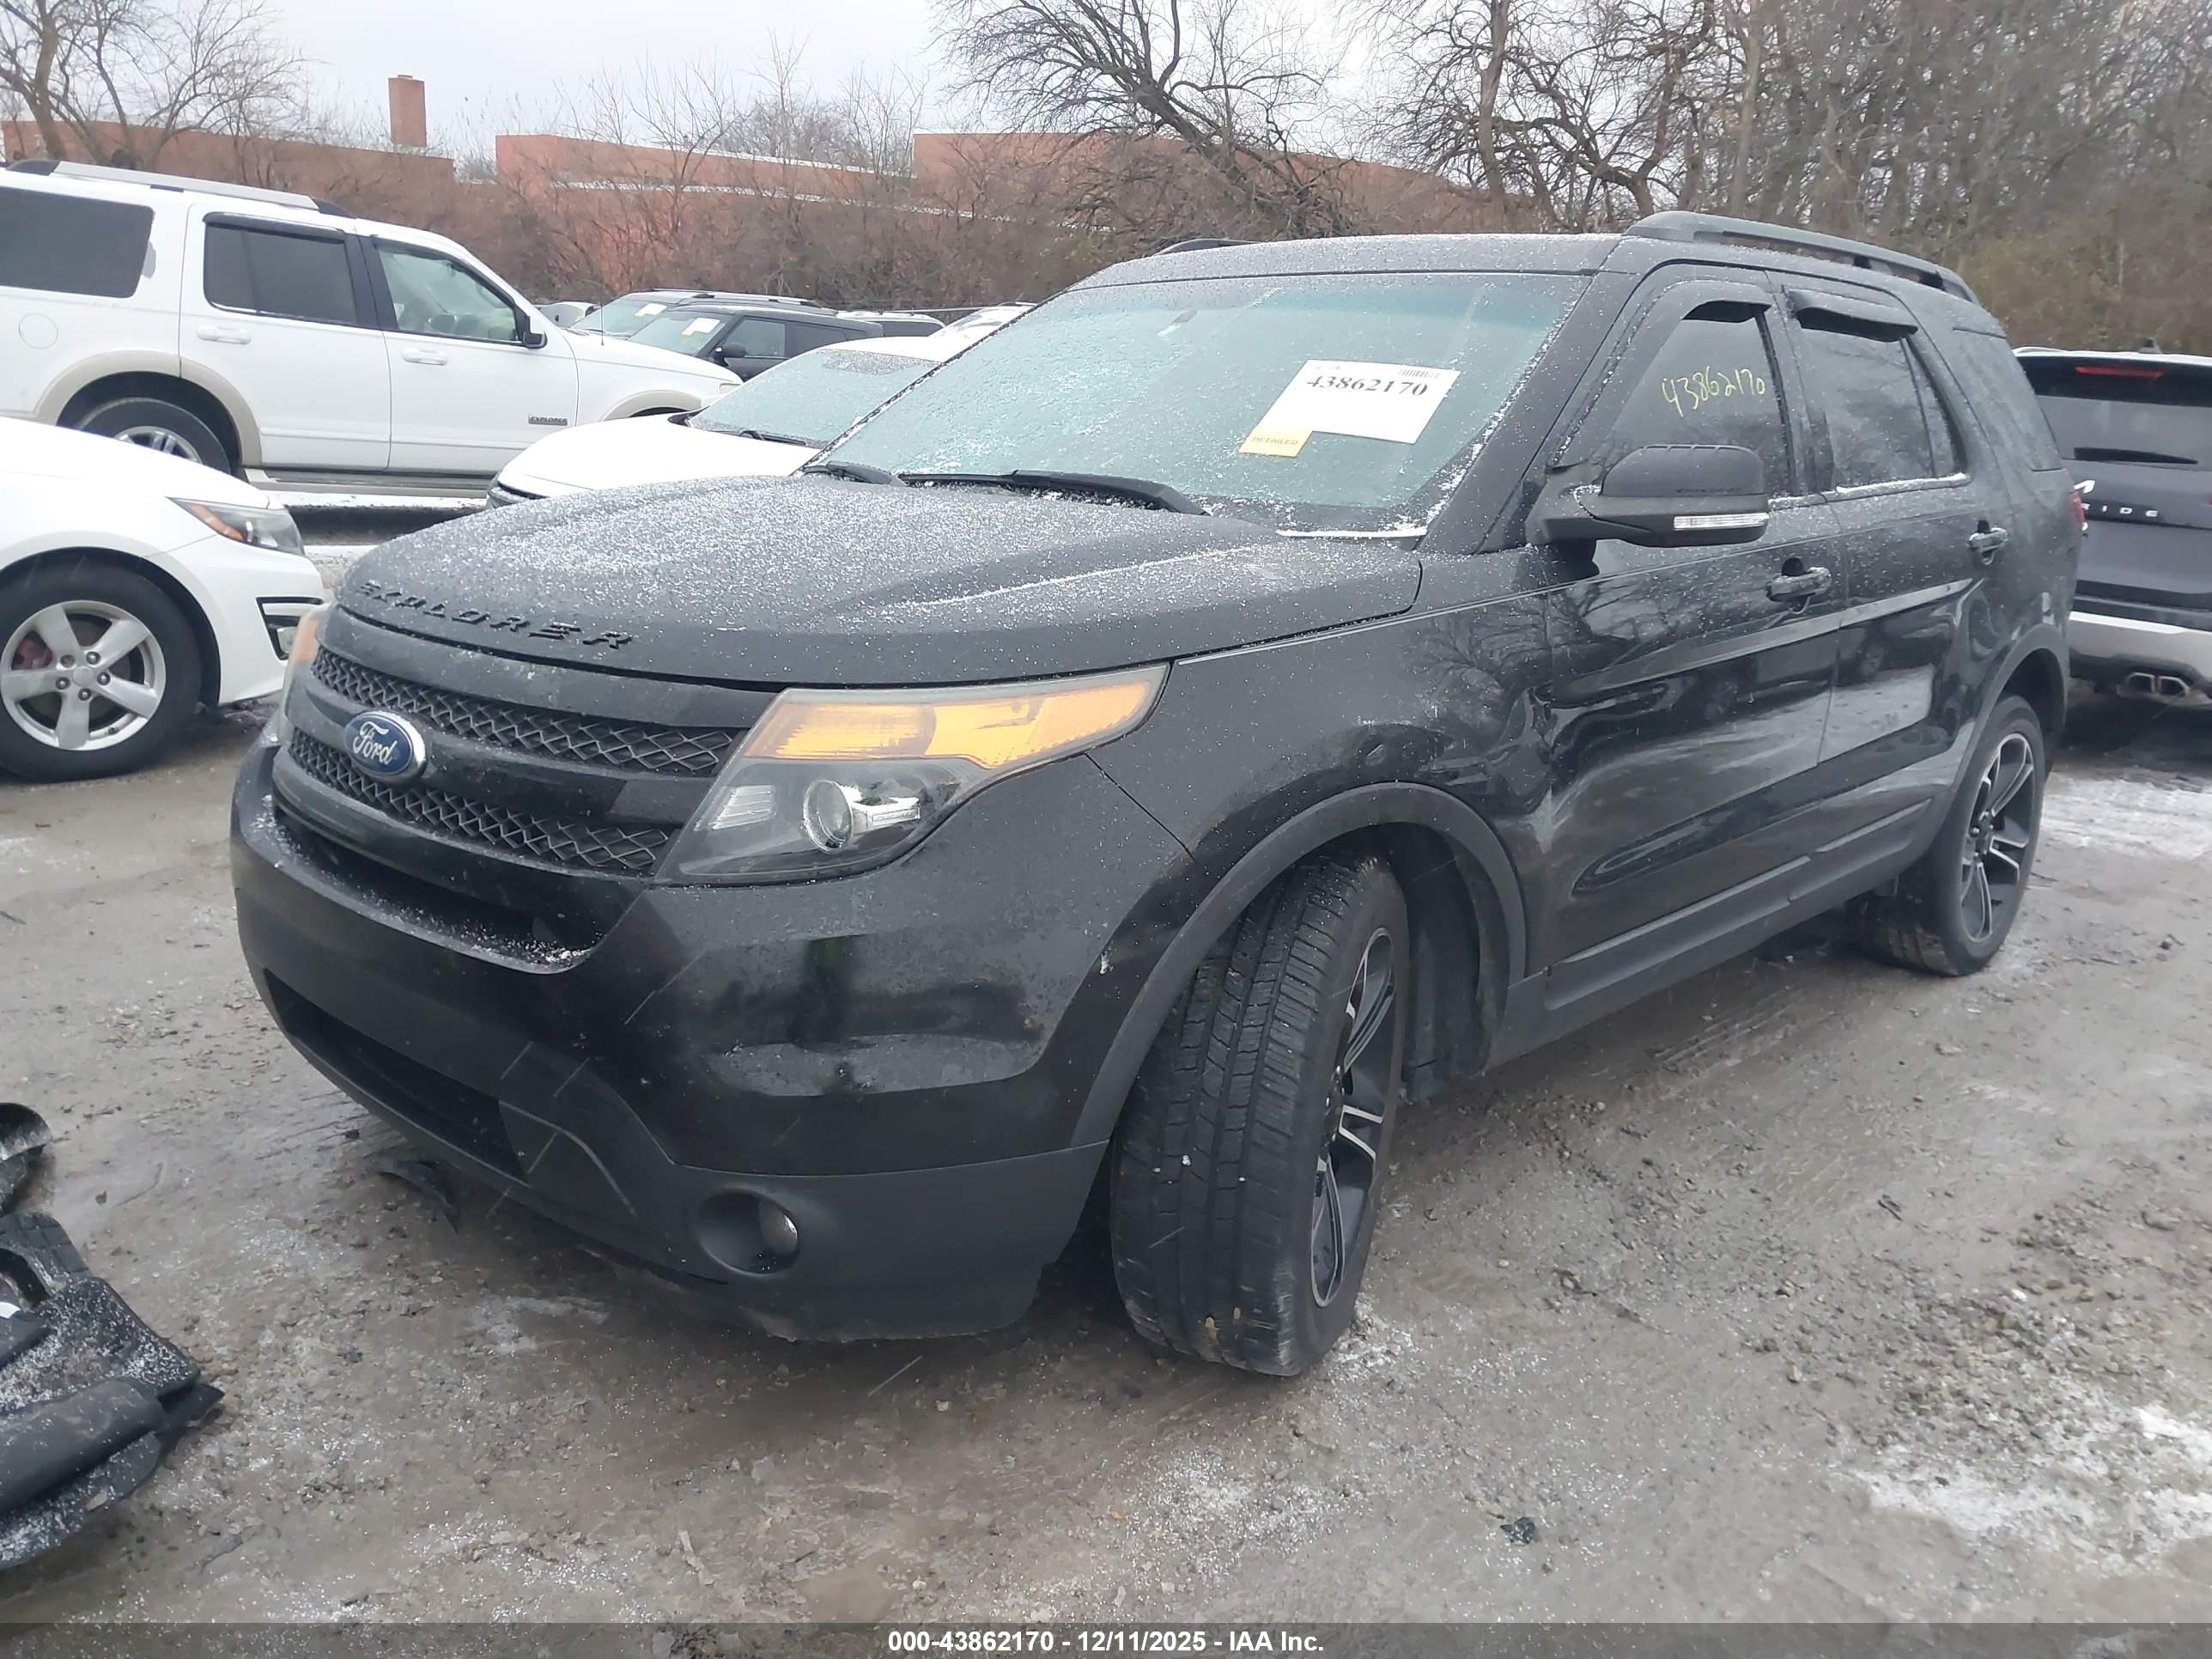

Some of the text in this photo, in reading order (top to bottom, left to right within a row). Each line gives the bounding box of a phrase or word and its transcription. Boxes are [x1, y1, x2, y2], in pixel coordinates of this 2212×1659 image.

[1305, 374, 1429, 397] 43862170
[1662, 365, 1766, 417] 43862170
[529, 416, 568, 424] EXPLORER
[1251, 436, 1299, 446] DETAILED
[352, 720, 398, 766] Ford
